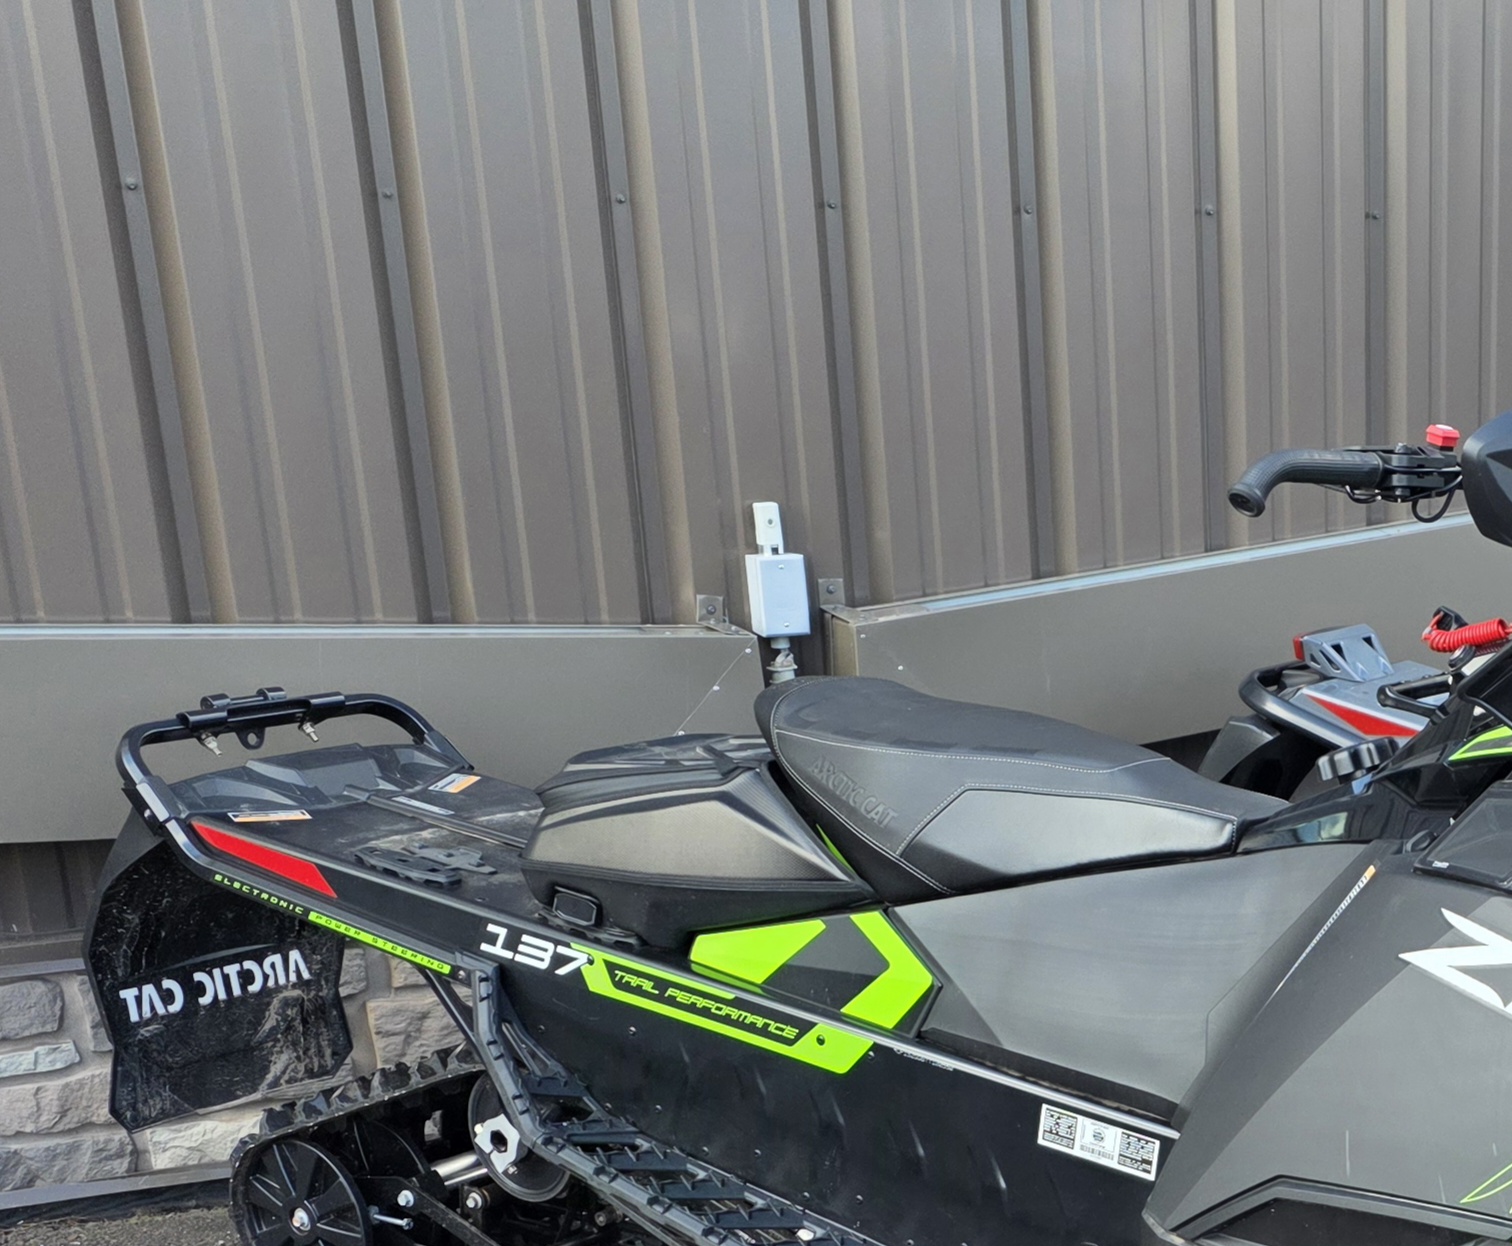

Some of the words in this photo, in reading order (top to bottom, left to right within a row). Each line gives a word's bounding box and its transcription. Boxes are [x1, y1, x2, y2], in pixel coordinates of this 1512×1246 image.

[812, 758, 866, 808] ARCTIC
[860, 795, 899, 829] CAT
[213, 872, 305, 915] ELECTRONIC
[314, 914, 362, 937] POWER
[371, 936, 445, 971] STEERING
[480, 923, 591, 976] 137
[613, 970, 660, 995] TRAIL
[663, 986, 800, 1040] PERFORMANCE
